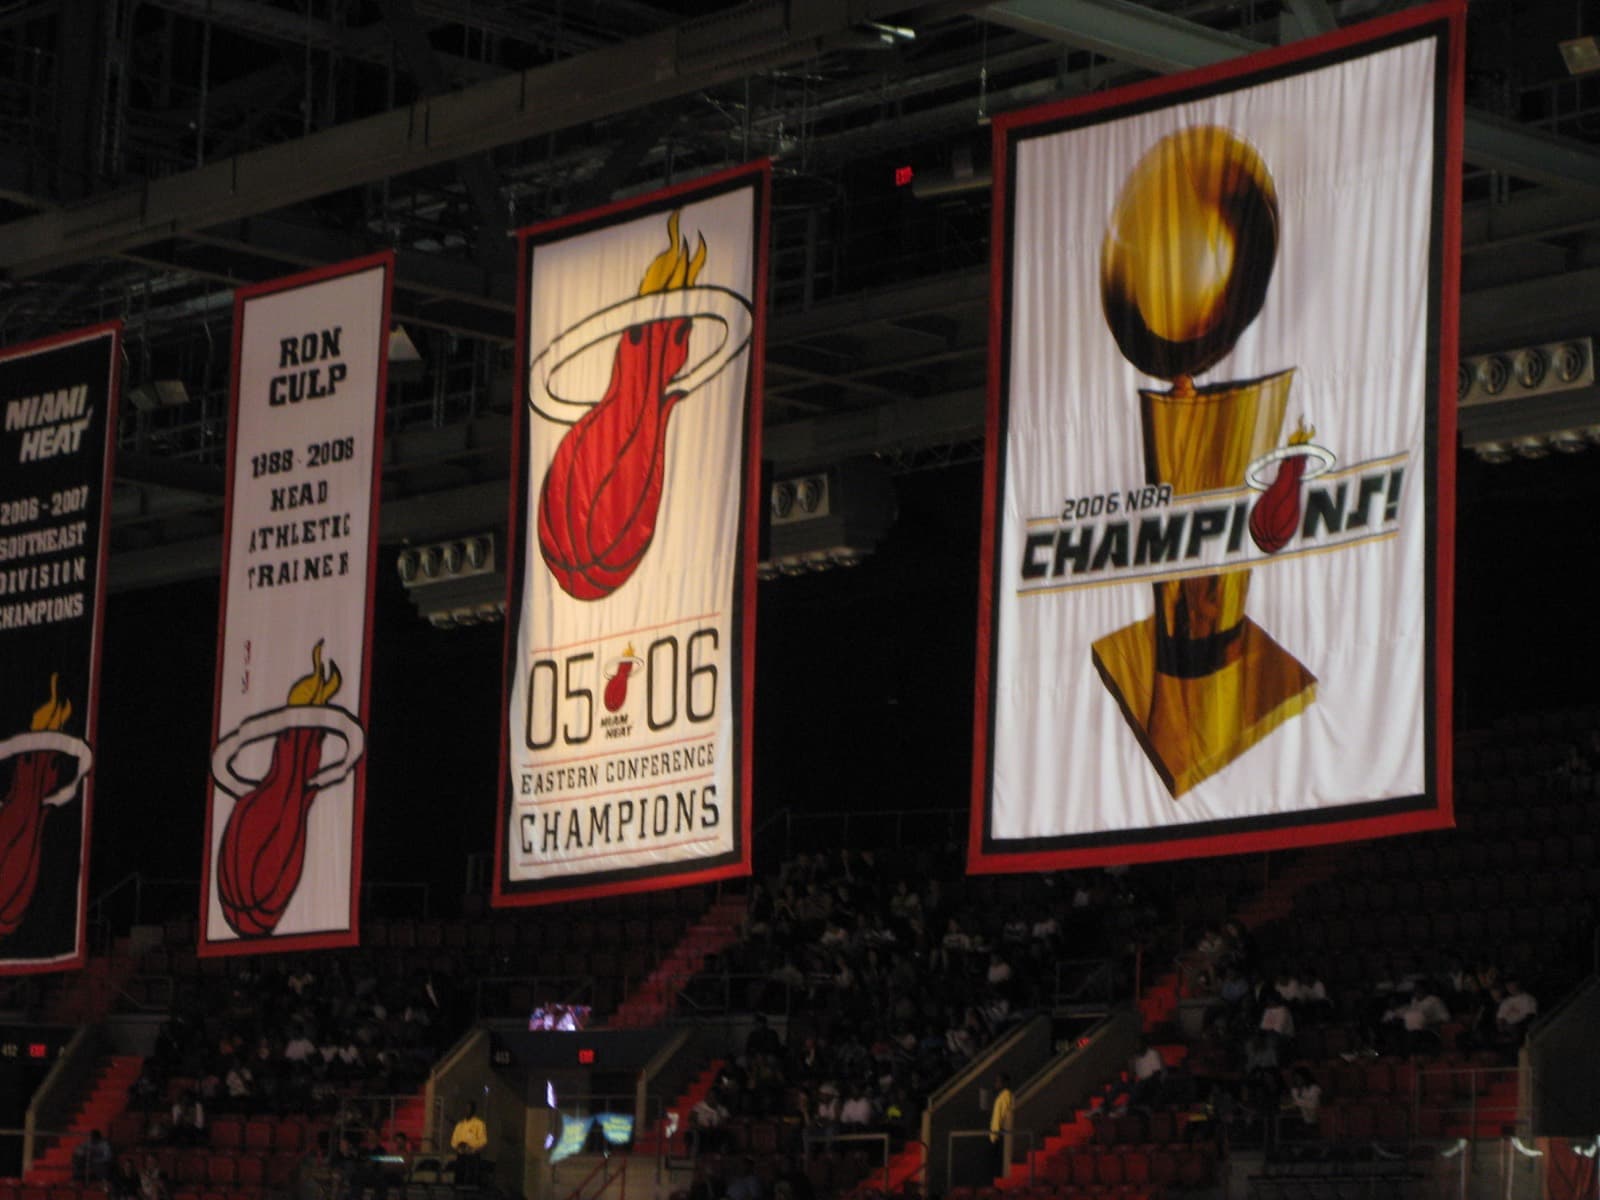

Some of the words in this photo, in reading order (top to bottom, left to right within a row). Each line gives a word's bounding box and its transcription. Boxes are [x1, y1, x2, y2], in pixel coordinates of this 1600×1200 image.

[279, 326, 342, 368] RON
[269, 362, 347, 406] CULP
[5, 383, 88, 431] MIAMI
[18, 405, 94, 463] HEAT
[307, 436, 354, 468] 2008
[51, 485, 88, 516] 2007
[270, 479, 328, 512] HEAD
[1062, 490, 1119, 522] 2006
[1125, 484, 1173, 514] NBA
[0, 521, 87, 561] SOUTHEAST
[0, 592, 84, 631] HAMPIONS
[525, 652, 594, 750] 05
[647, 628, 719, 732] 06
[521, 764, 599, 795] EASTERN
[606, 743, 715, 783] CONFERENCE
[520, 785, 720, 854] CHAMPIONS
